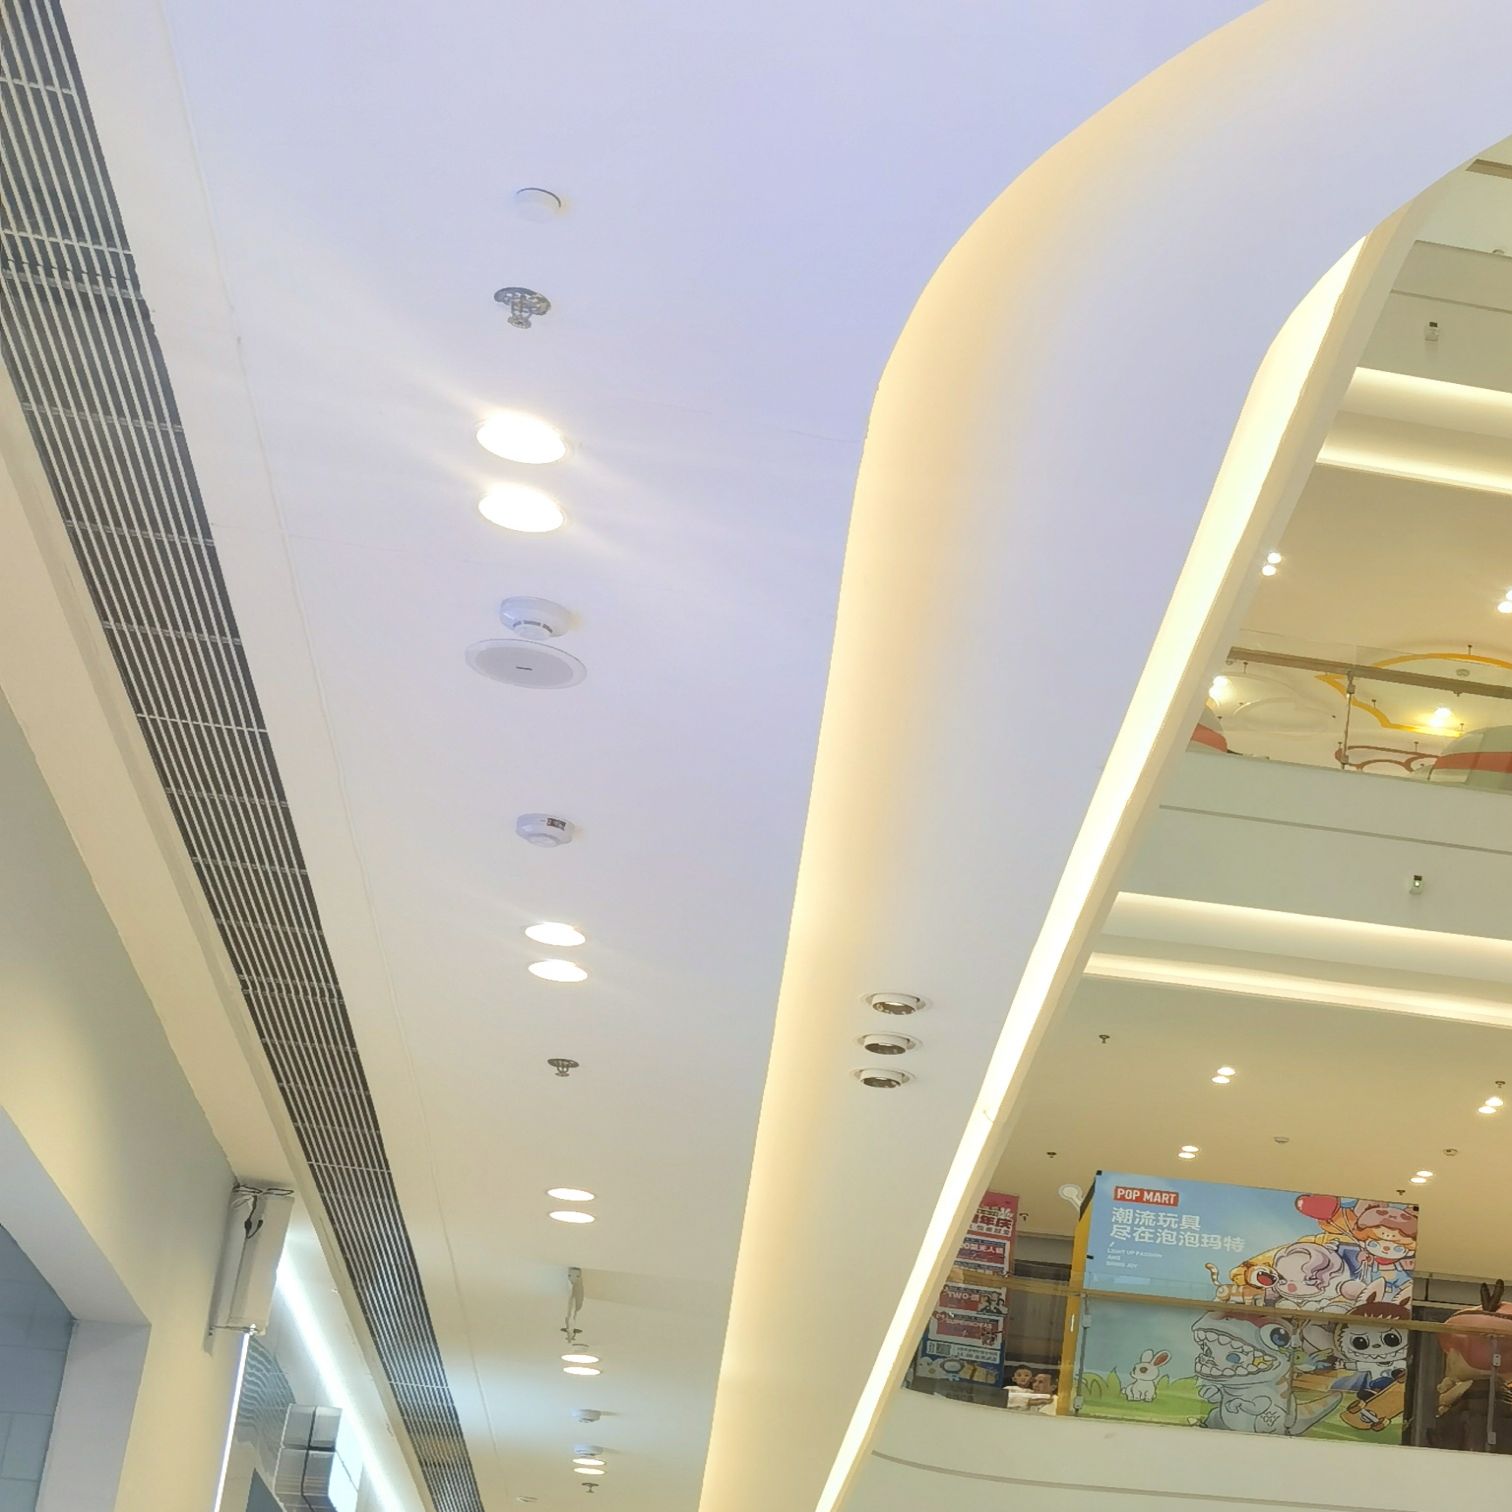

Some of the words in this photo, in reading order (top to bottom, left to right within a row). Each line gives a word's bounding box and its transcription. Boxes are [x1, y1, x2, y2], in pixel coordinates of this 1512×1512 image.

[1116, 1188, 1140, 1200] POP
[1143, 1192, 1177, 1204] MART
[1112, 1207, 1201, 1231] 潮流玩具
[1110, 1225, 1246, 1252] 尽在泡泡玛特
